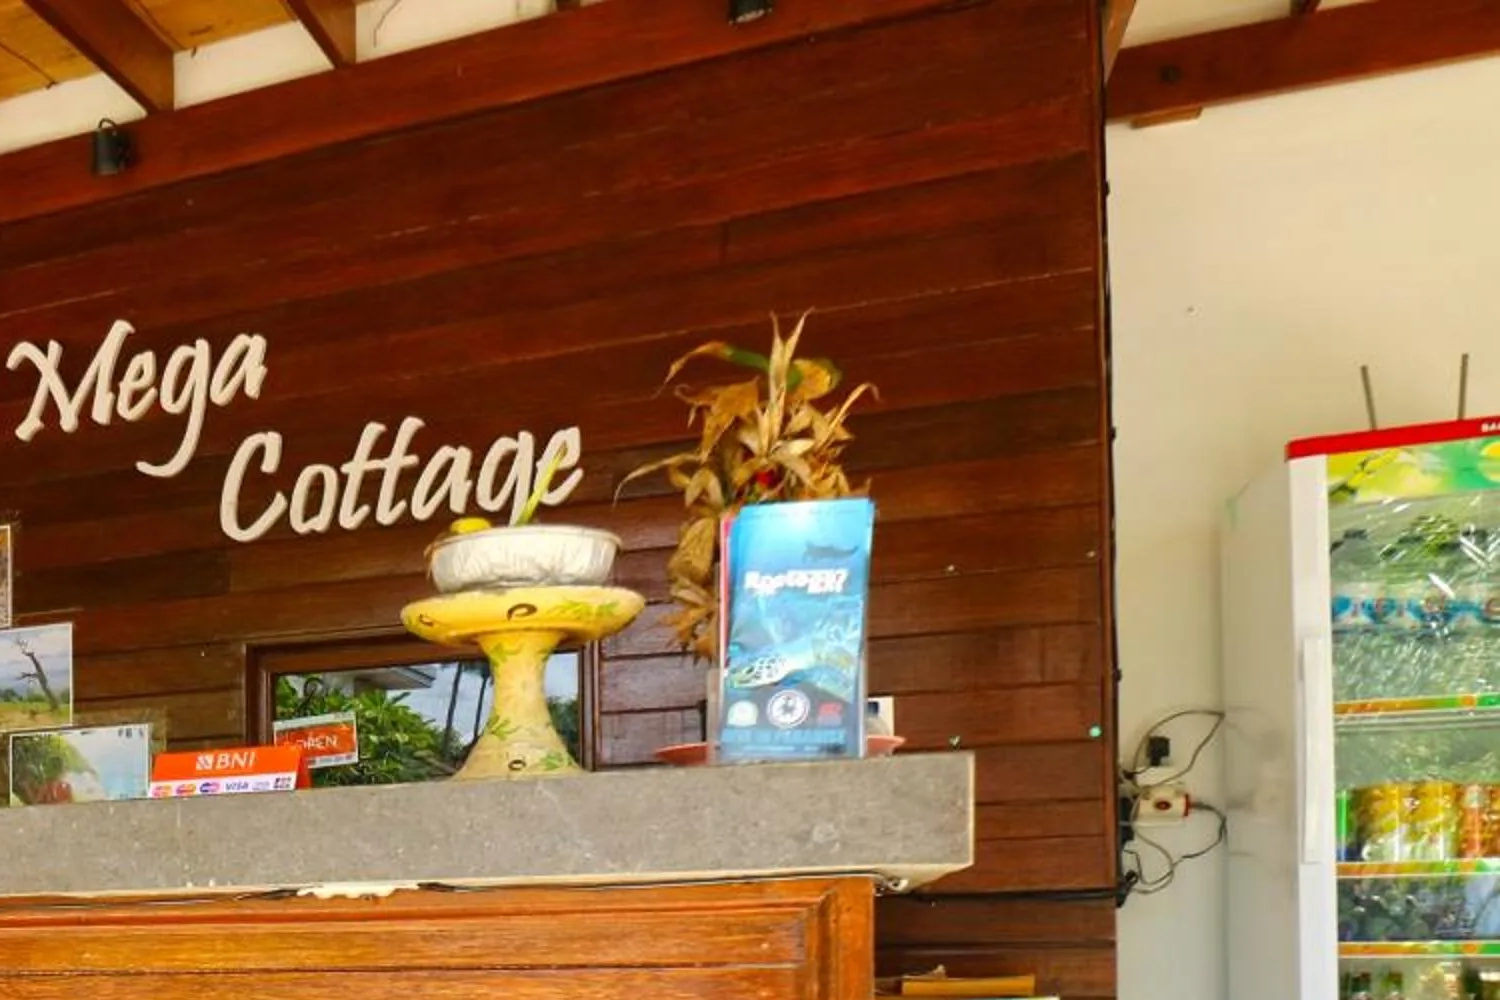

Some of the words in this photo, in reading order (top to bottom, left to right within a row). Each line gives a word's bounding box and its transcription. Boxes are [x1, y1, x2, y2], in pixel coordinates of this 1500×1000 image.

[6, 319, 268, 478] Mega
[220, 416, 584, 542] Cottage
[215, 751, 256, 769] BNI
